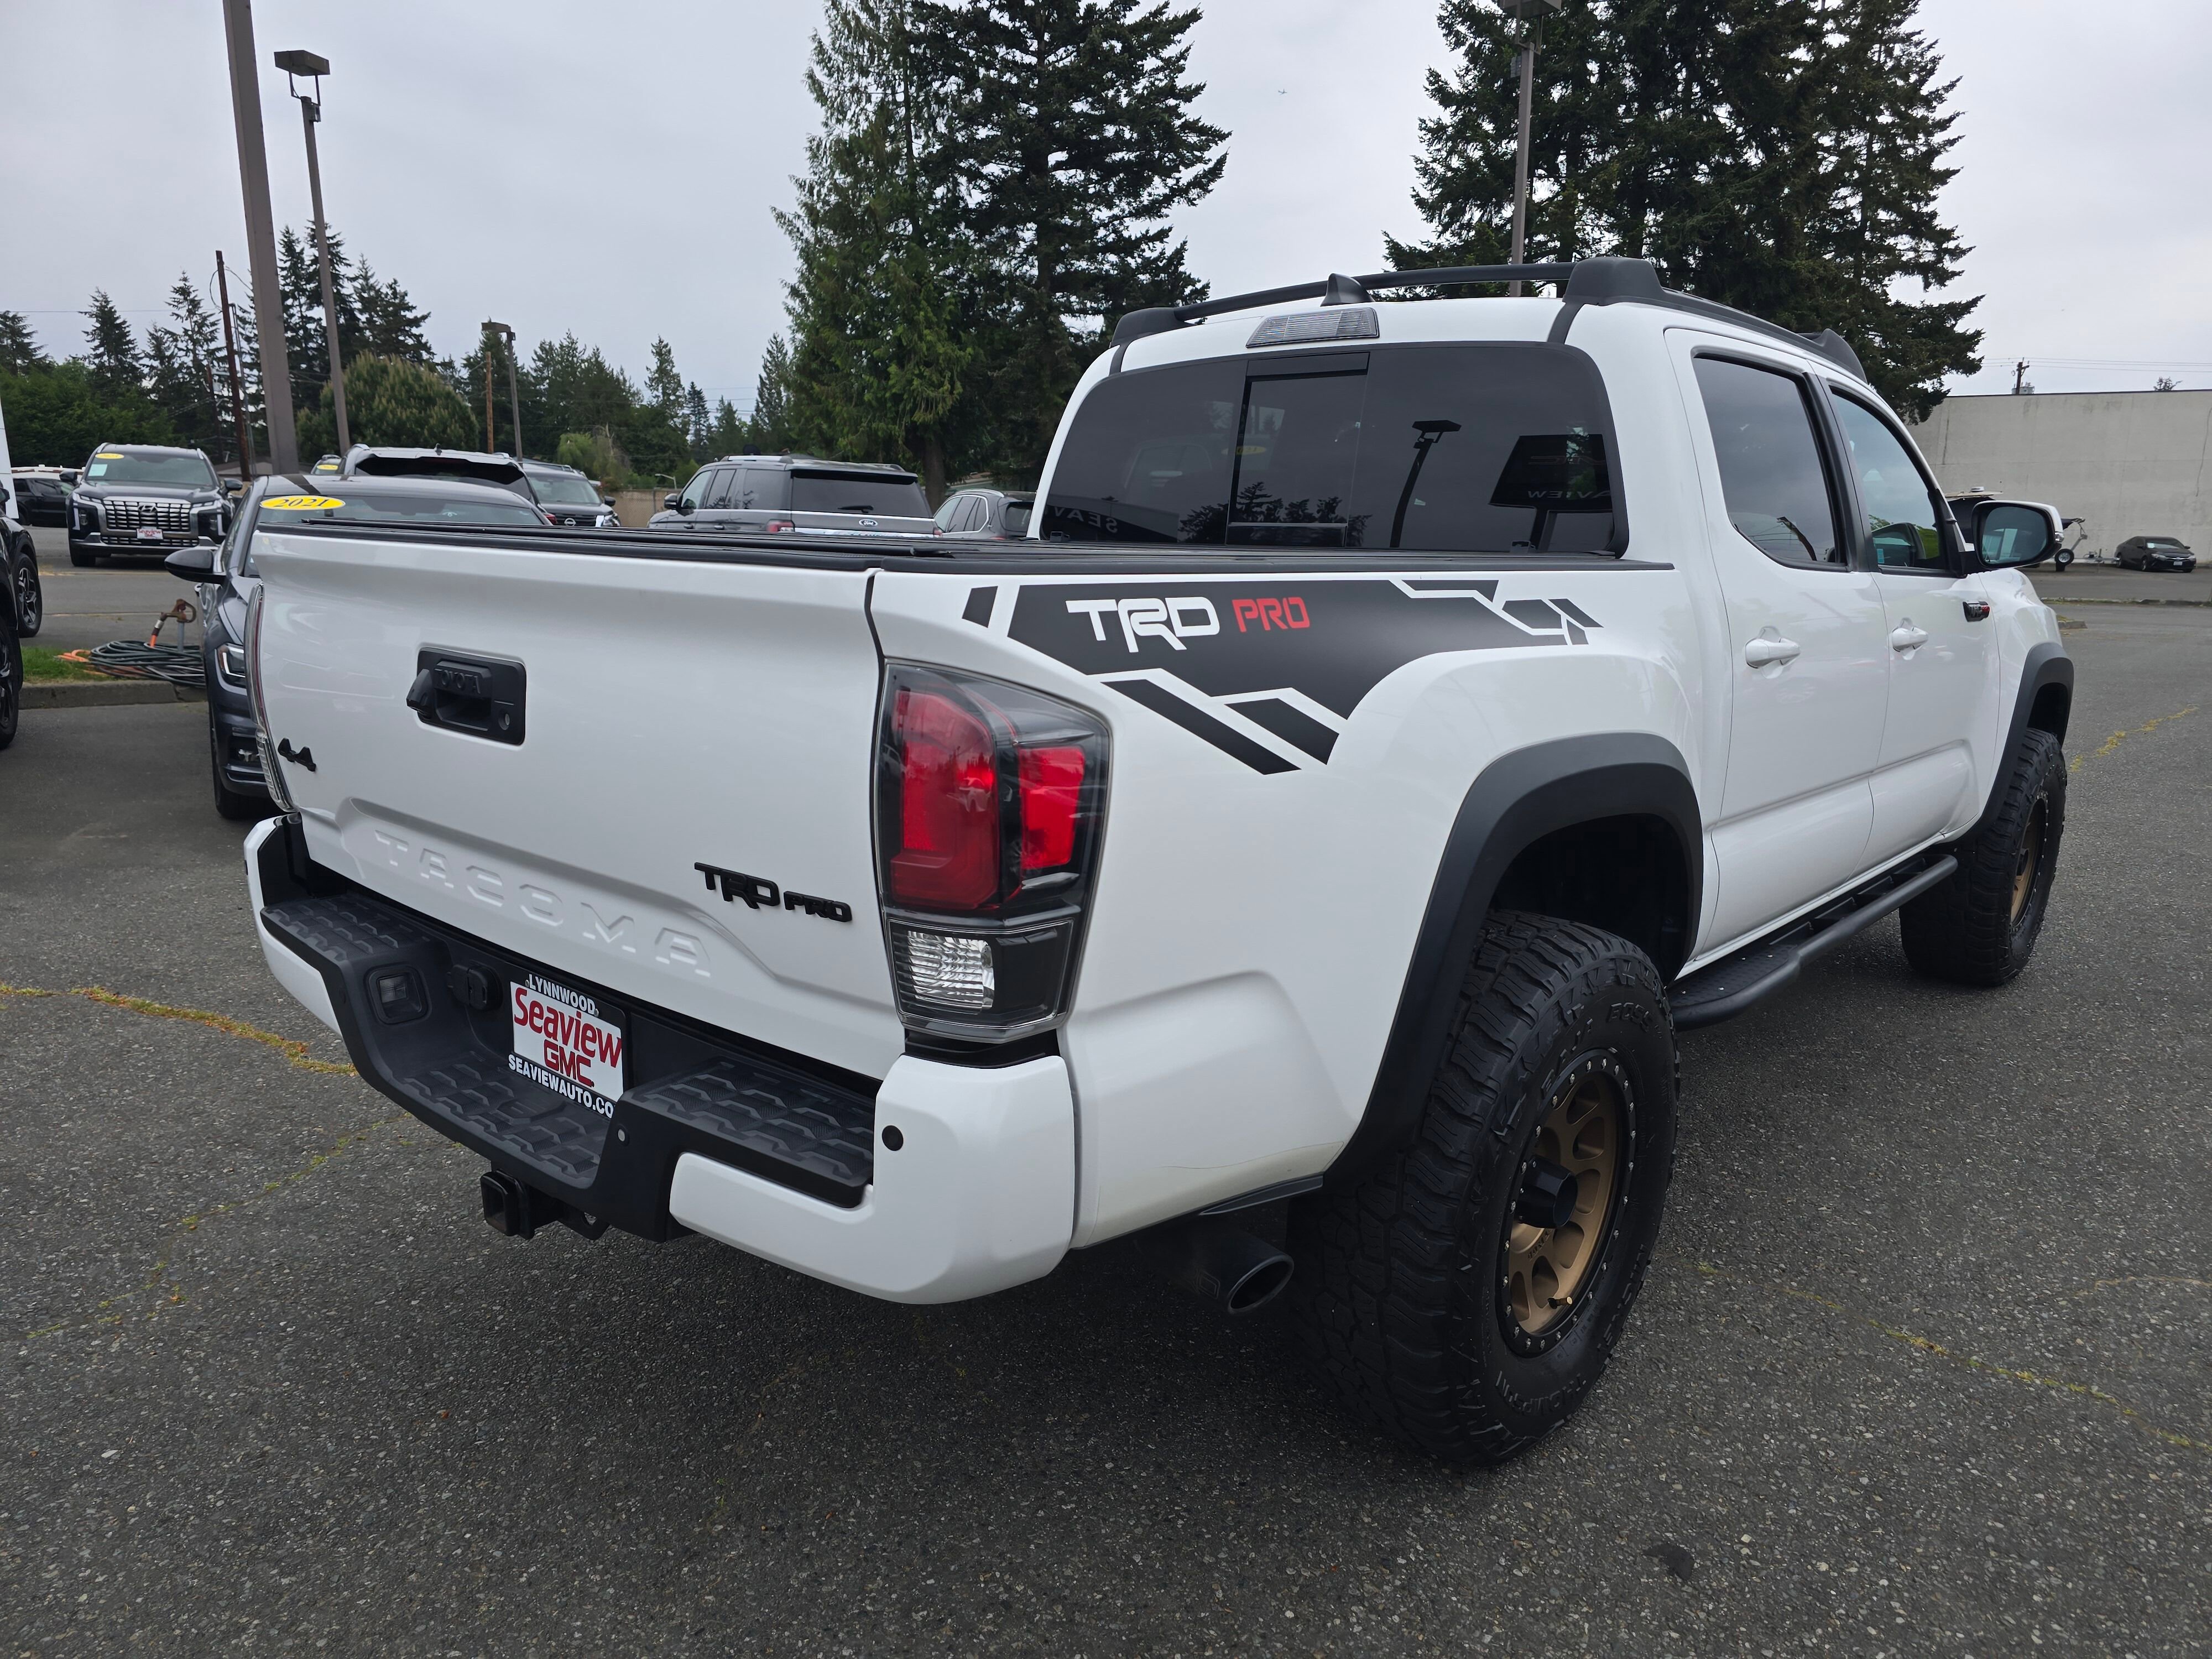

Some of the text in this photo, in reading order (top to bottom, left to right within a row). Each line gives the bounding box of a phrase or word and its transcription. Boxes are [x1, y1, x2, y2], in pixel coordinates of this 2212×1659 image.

[274, 498, 328, 507] 2021
[1066, 597, 1310, 653] TRD PRO
[375, 830, 711, 978] TACOMA
[694, 862, 852, 922] TRD PRO
[528, 973, 596, 1015] LYNNWOOD
[514, 987, 622, 1068] Seaview
[508, 1054, 615, 1119] SEAVIEWAUTO.CO
[544, 1039, 595, 1088] GMC
